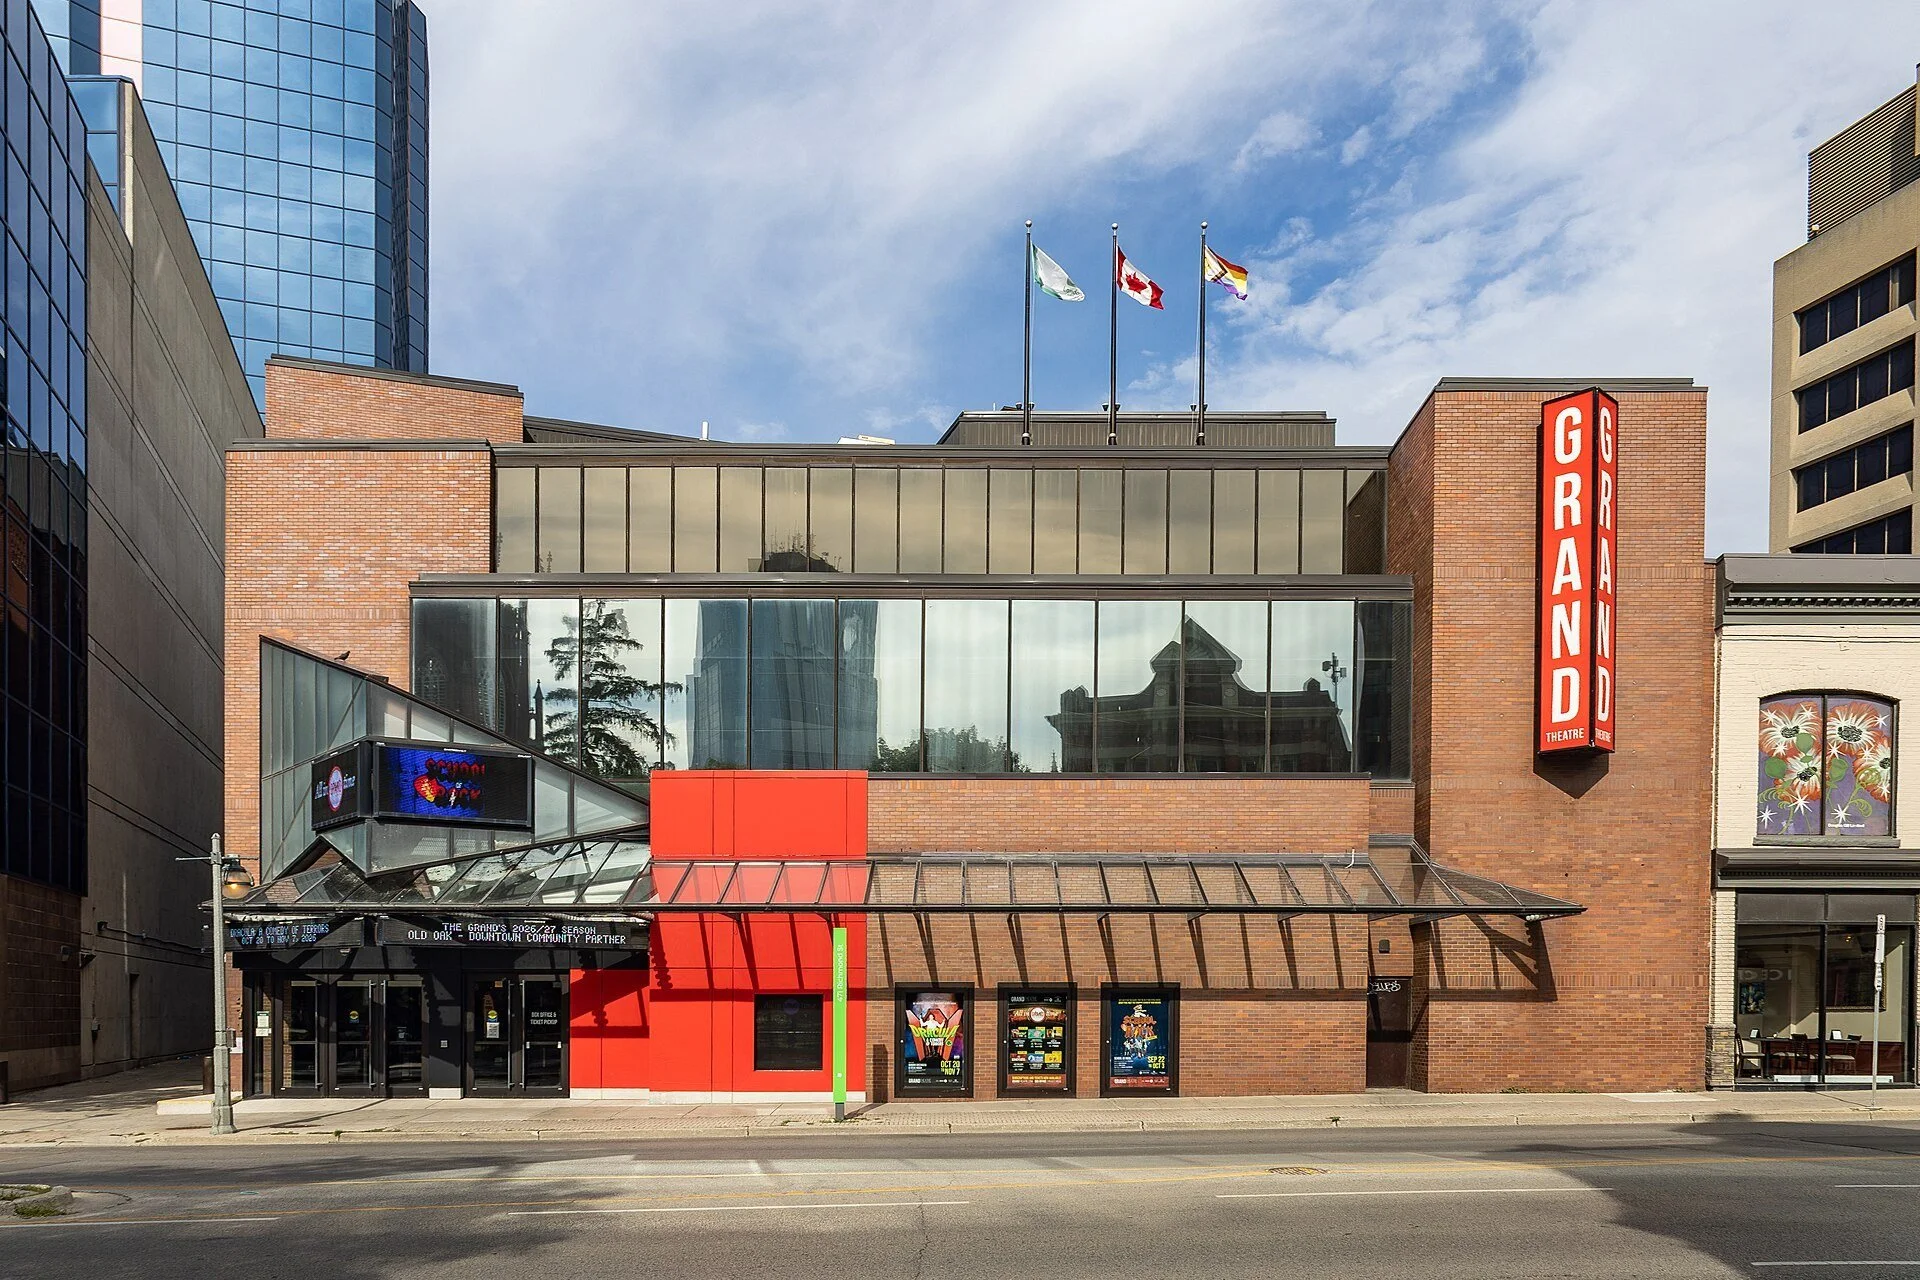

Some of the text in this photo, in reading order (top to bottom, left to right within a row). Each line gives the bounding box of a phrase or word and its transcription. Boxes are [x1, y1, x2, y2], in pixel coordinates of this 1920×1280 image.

[1551, 406, 1583, 724] GRAND
[1598, 406, 1612, 723] GRAND
[1546, 728, 1585, 743] THEATRE
[1595, 728, 1611, 743] THEATRE
[259, 927, 263, 936] A
[266, 926, 289, 935] COMEDY
[292, 926, 299, 934] OF
[303, 924, 330, 934] TERRORS
[442, 923, 596, 934] THE GRAND'S 2026/27 SEASON
[242, 936, 253, 944] OCT
[256, 936, 263, 944] 20
[277, 935, 289, 943] NOV
[408, 930, 427, 940] OLD
[433, 931, 452, 941] OAK
[469, 932, 521, 942] DOWNTOWN
[526, 933, 580, 943] COMMUNITY
[585, 934, 626, 944] PARTNER
[909, 1024, 960, 1038] DRACULA
[940, 1060, 960, 1068] OCT 20
[944, 1068, 956, 1076] NOV
[956, 1068, 960, 1076] 7
